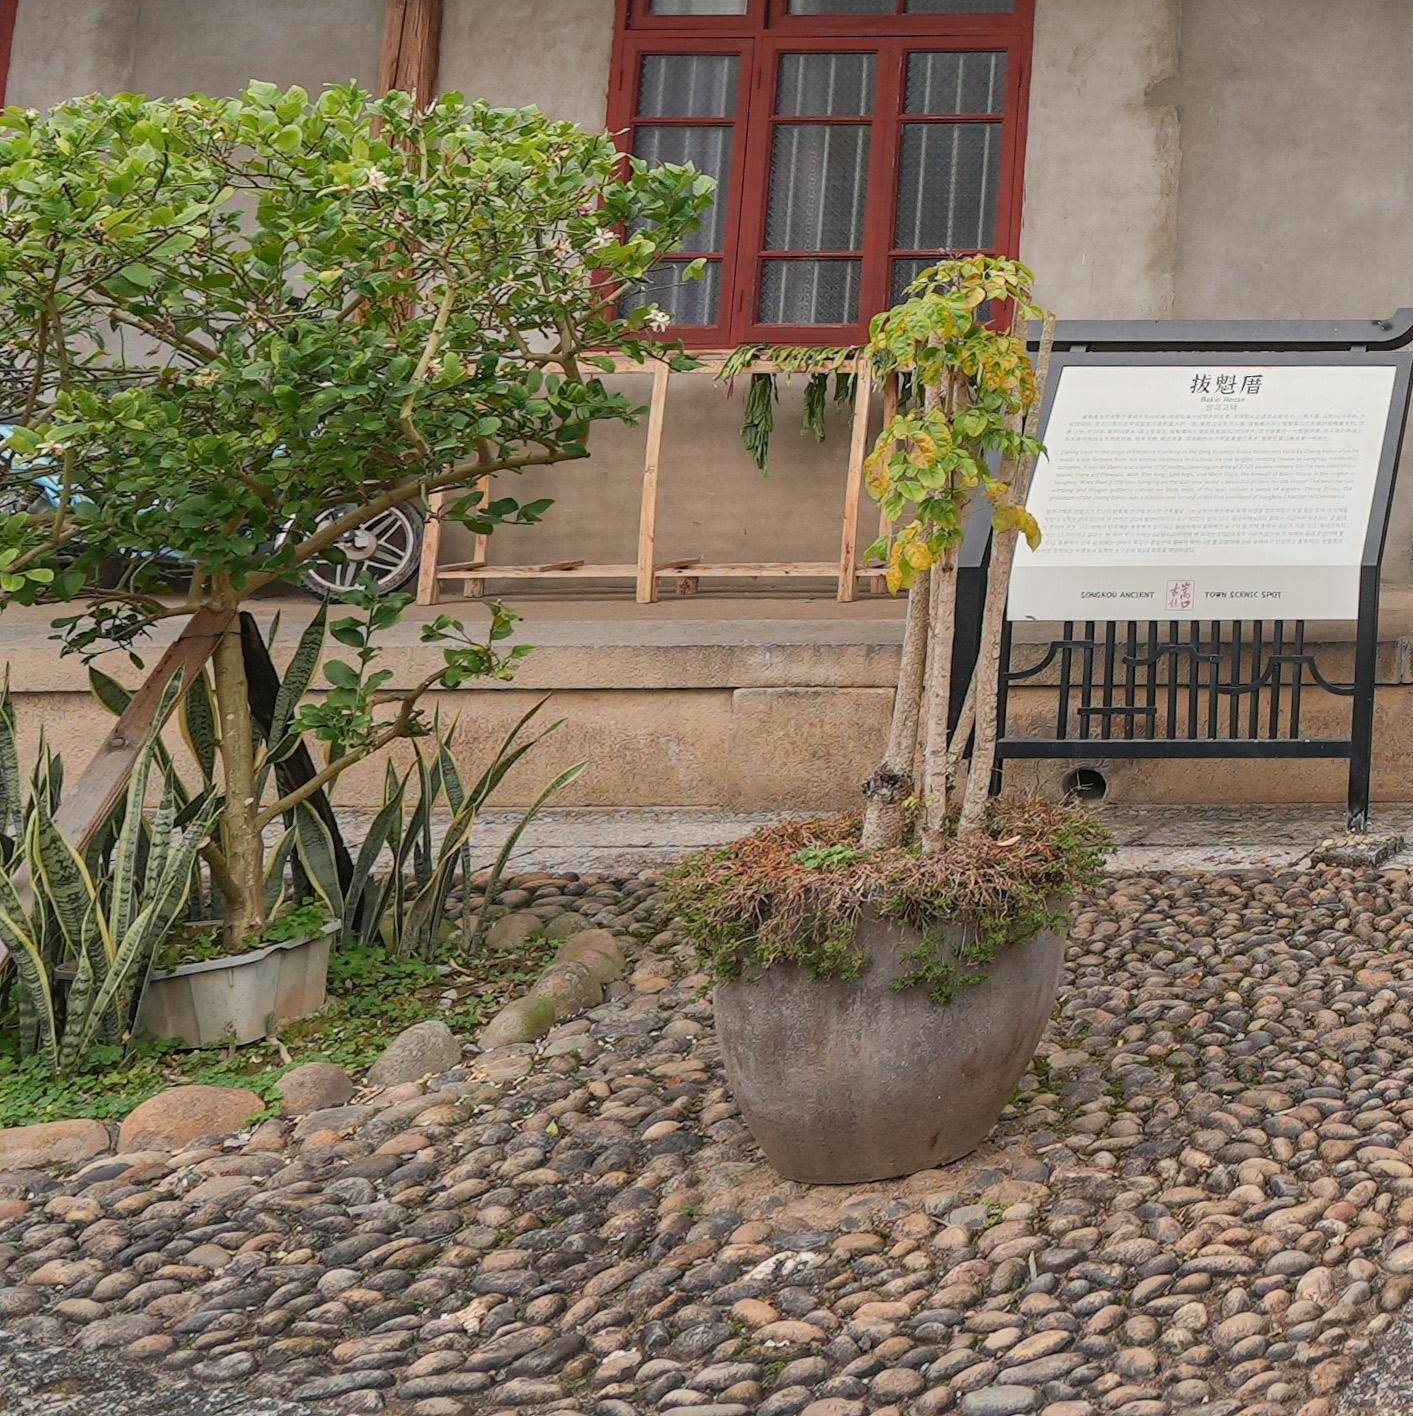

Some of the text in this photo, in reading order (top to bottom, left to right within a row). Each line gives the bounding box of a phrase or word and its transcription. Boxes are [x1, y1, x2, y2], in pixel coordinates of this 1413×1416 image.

[1190, 373, 1263, 395] 拔魁厝
[1080, 590, 1154, 599] SONGKOU ANCIENT
[1204, 590, 1282, 599] TOWN SCENIC SPOT
